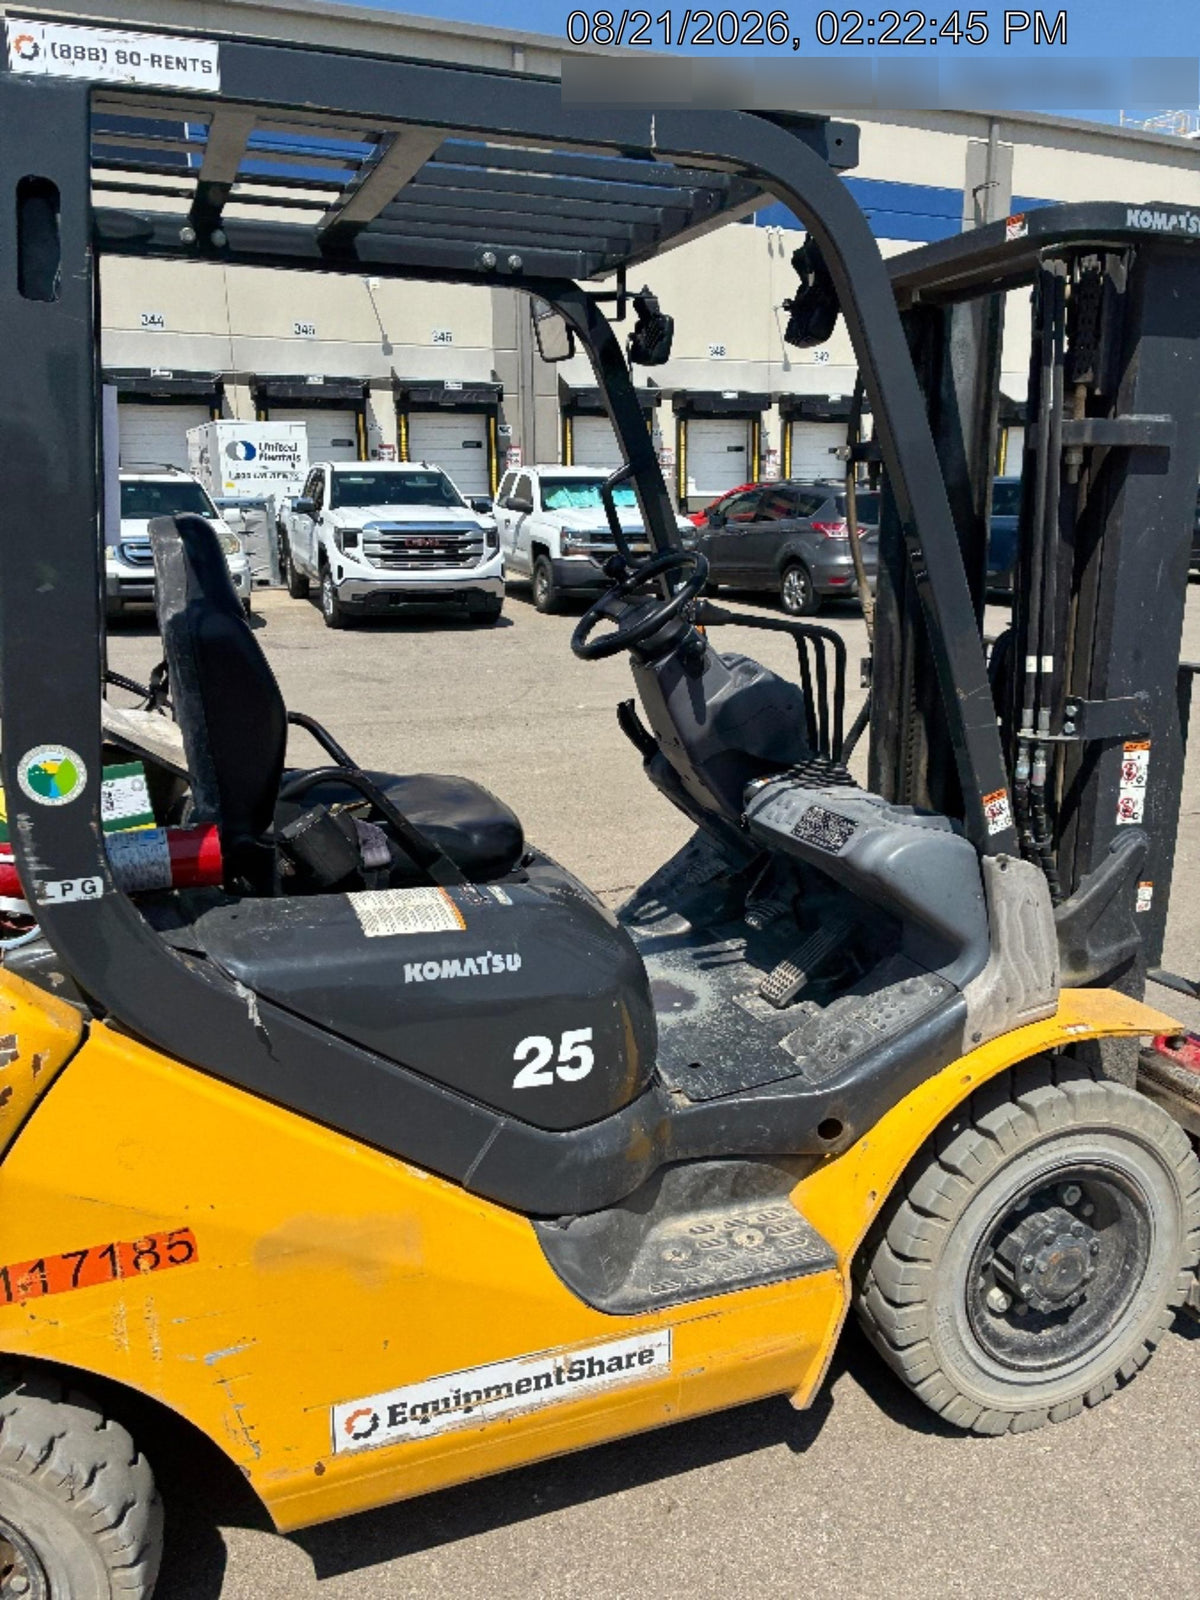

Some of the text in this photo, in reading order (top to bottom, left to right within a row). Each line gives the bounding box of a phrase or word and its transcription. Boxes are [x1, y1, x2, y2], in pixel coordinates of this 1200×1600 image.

[51, 42, 213, 74] (888) 80-RENTS
[1126, 208, 1200, 234] KOMATS
[258, 442, 297, 452] United
[403, 950, 522, 984] KOMATSU
[512, 1026, 595, 1089] 25
[386, 1347, 656, 1426] EquipmentShare
